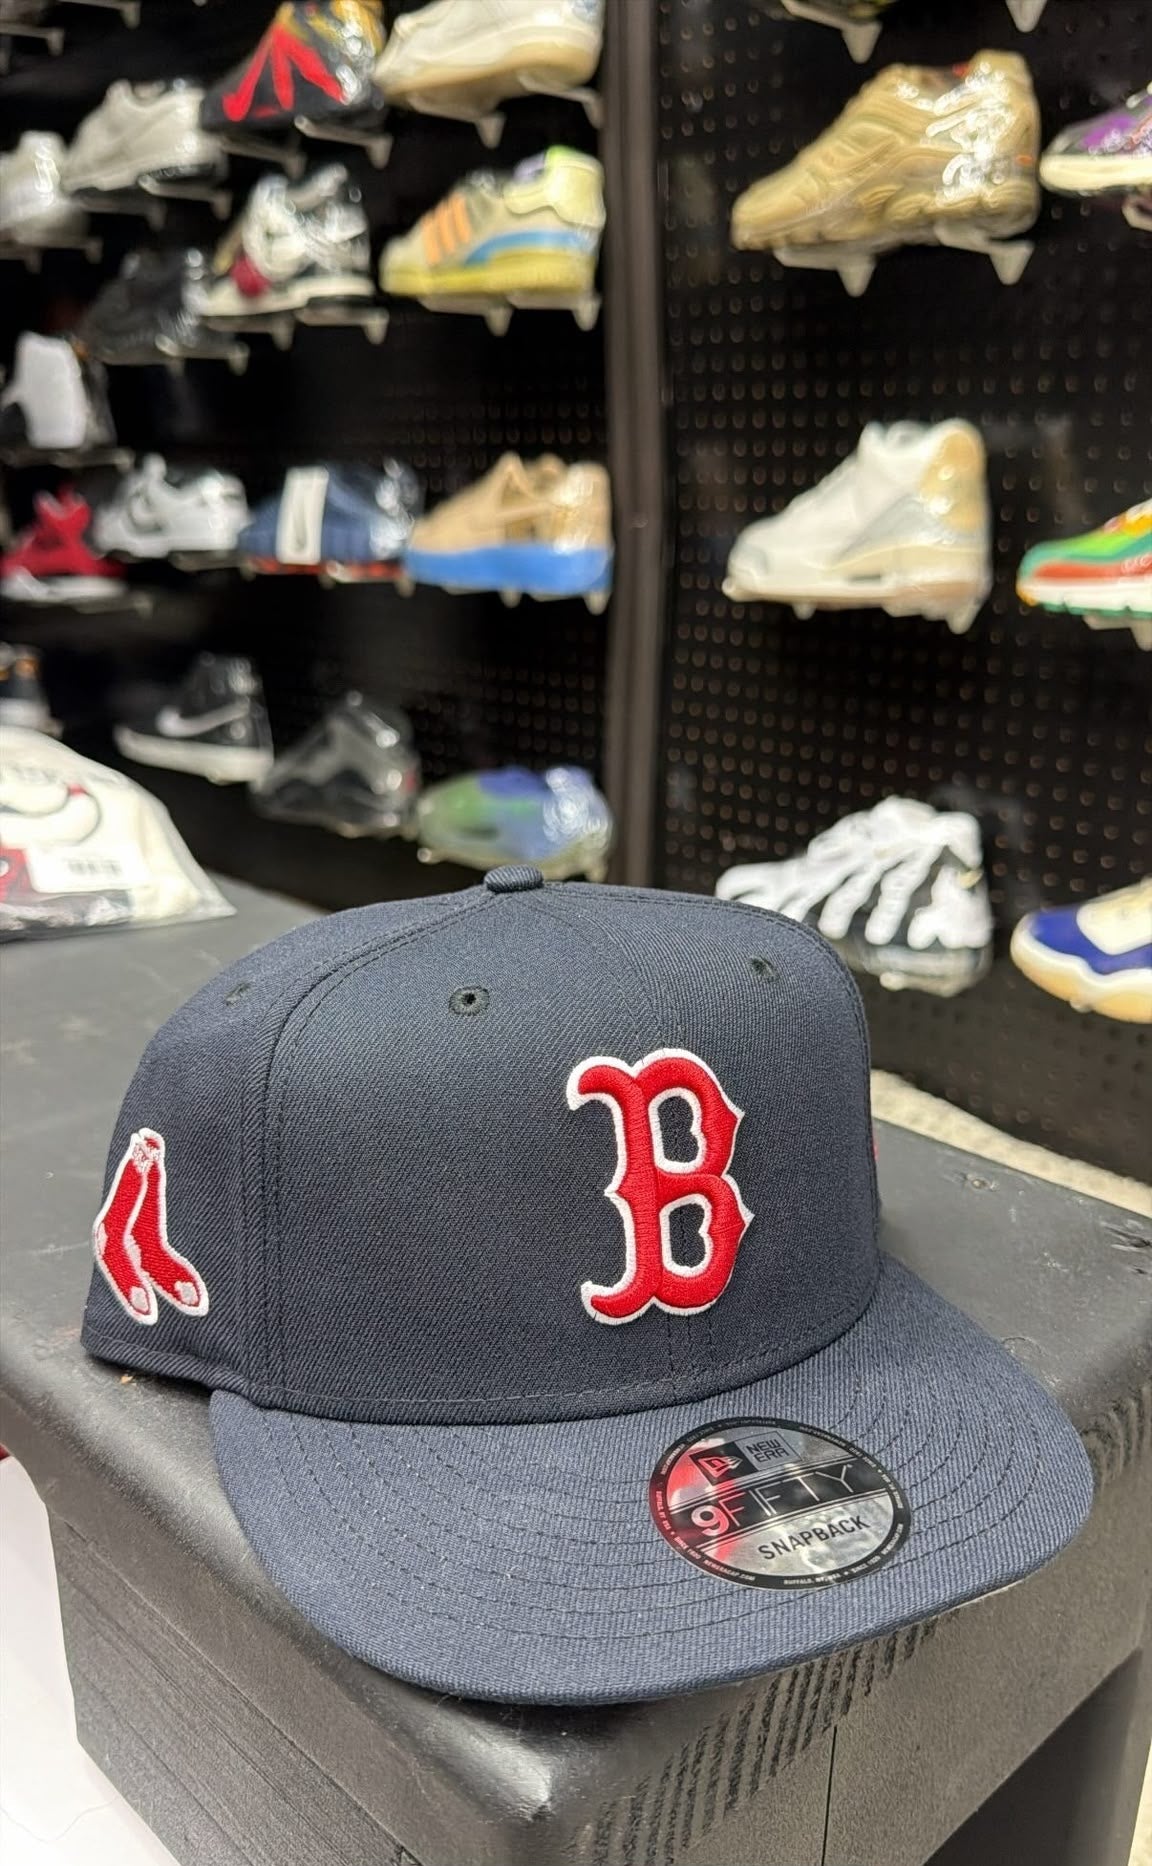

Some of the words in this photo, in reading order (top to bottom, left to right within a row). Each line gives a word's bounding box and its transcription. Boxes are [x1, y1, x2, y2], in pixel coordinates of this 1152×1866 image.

[566, 1048, 755, 1325] B
[746, 1438, 780, 1454] NEW
[753, 1448, 790, 1463] ERA
[691, 1464, 853, 1537] 9FIFTY
[758, 1515, 871, 1560] SNAPBACK
